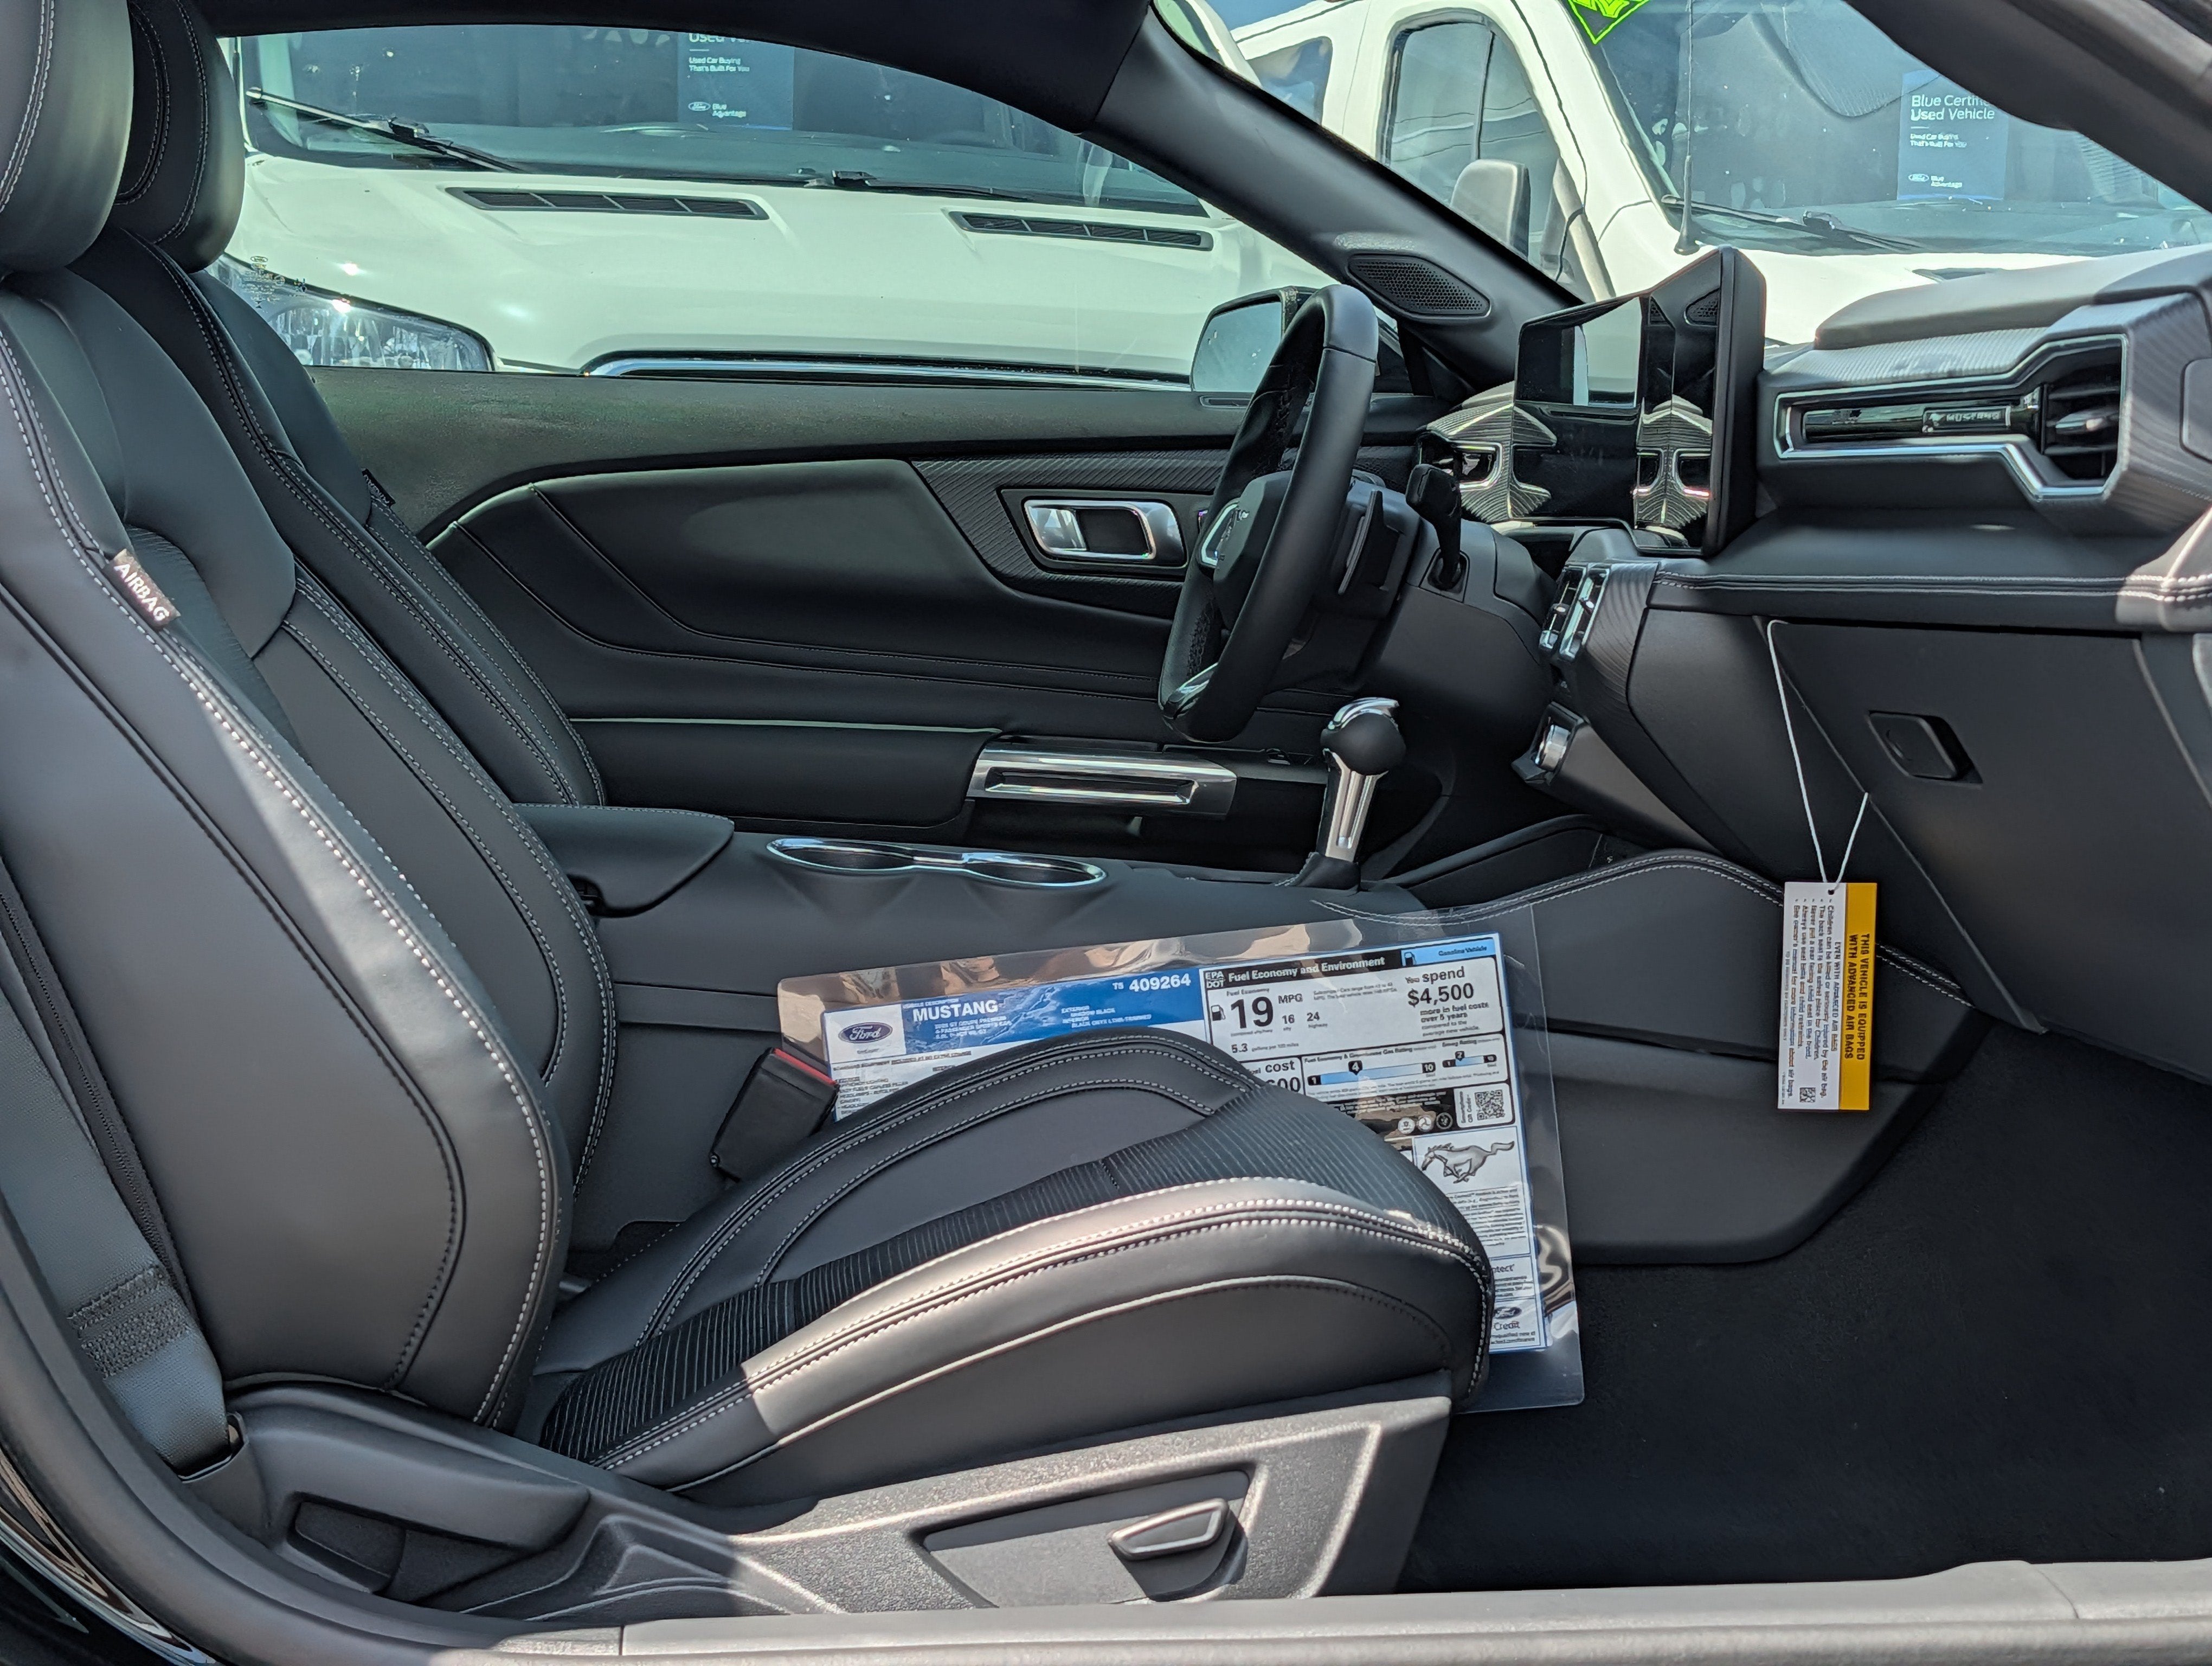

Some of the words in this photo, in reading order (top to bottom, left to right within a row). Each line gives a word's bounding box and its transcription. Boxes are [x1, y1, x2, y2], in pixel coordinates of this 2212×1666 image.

[1912, 94, 1941, 107] Blue
[1911, 108, 1944, 121] Used
[1949, 107, 1995, 120] Vehicle
[114, 564, 169, 621] AIRBAG
[1849, 934, 1858, 958] WITH
[1861, 934, 1870, 954] THIS
[1205, 971, 1224, 979] EPA
[1229, 972, 1249, 982] Fuel
[1252, 967, 1298, 981] Economy
[1301, 964, 1319, 974] and
[1321, 957, 1385, 972] Environment
[1422, 966, 1465, 984] spend
[1859, 959, 1869, 997] VEHICLE
[1129, 973, 1191, 992] 409264
[1206, 980, 1224, 988] DOT
[1847, 962, 1857, 1011] ADVANCED
[1278, 994, 1303, 1004] MPG
[1408, 983, 1474, 1008] $4,500
[913, 1000, 998, 1022] MUSTANG
[1231, 997, 1274, 1029] 19
[1858, 1001, 1867, 1009] IS
[1307, 1011, 1320, 1021] 24
[1846, 1015, 1855, 1030] AIR
[850, 1026, 881, 1040] Ford
[1857, 1013, 1867, 1060] EQUIPPED
[1231, 1043, 1248, 1053] 5.3
[1845, 1034, 1854, 1059] BAGS
[1265, 1060, 1295, 1073] cost
[1352, 1062, 1359, 1071] 4
